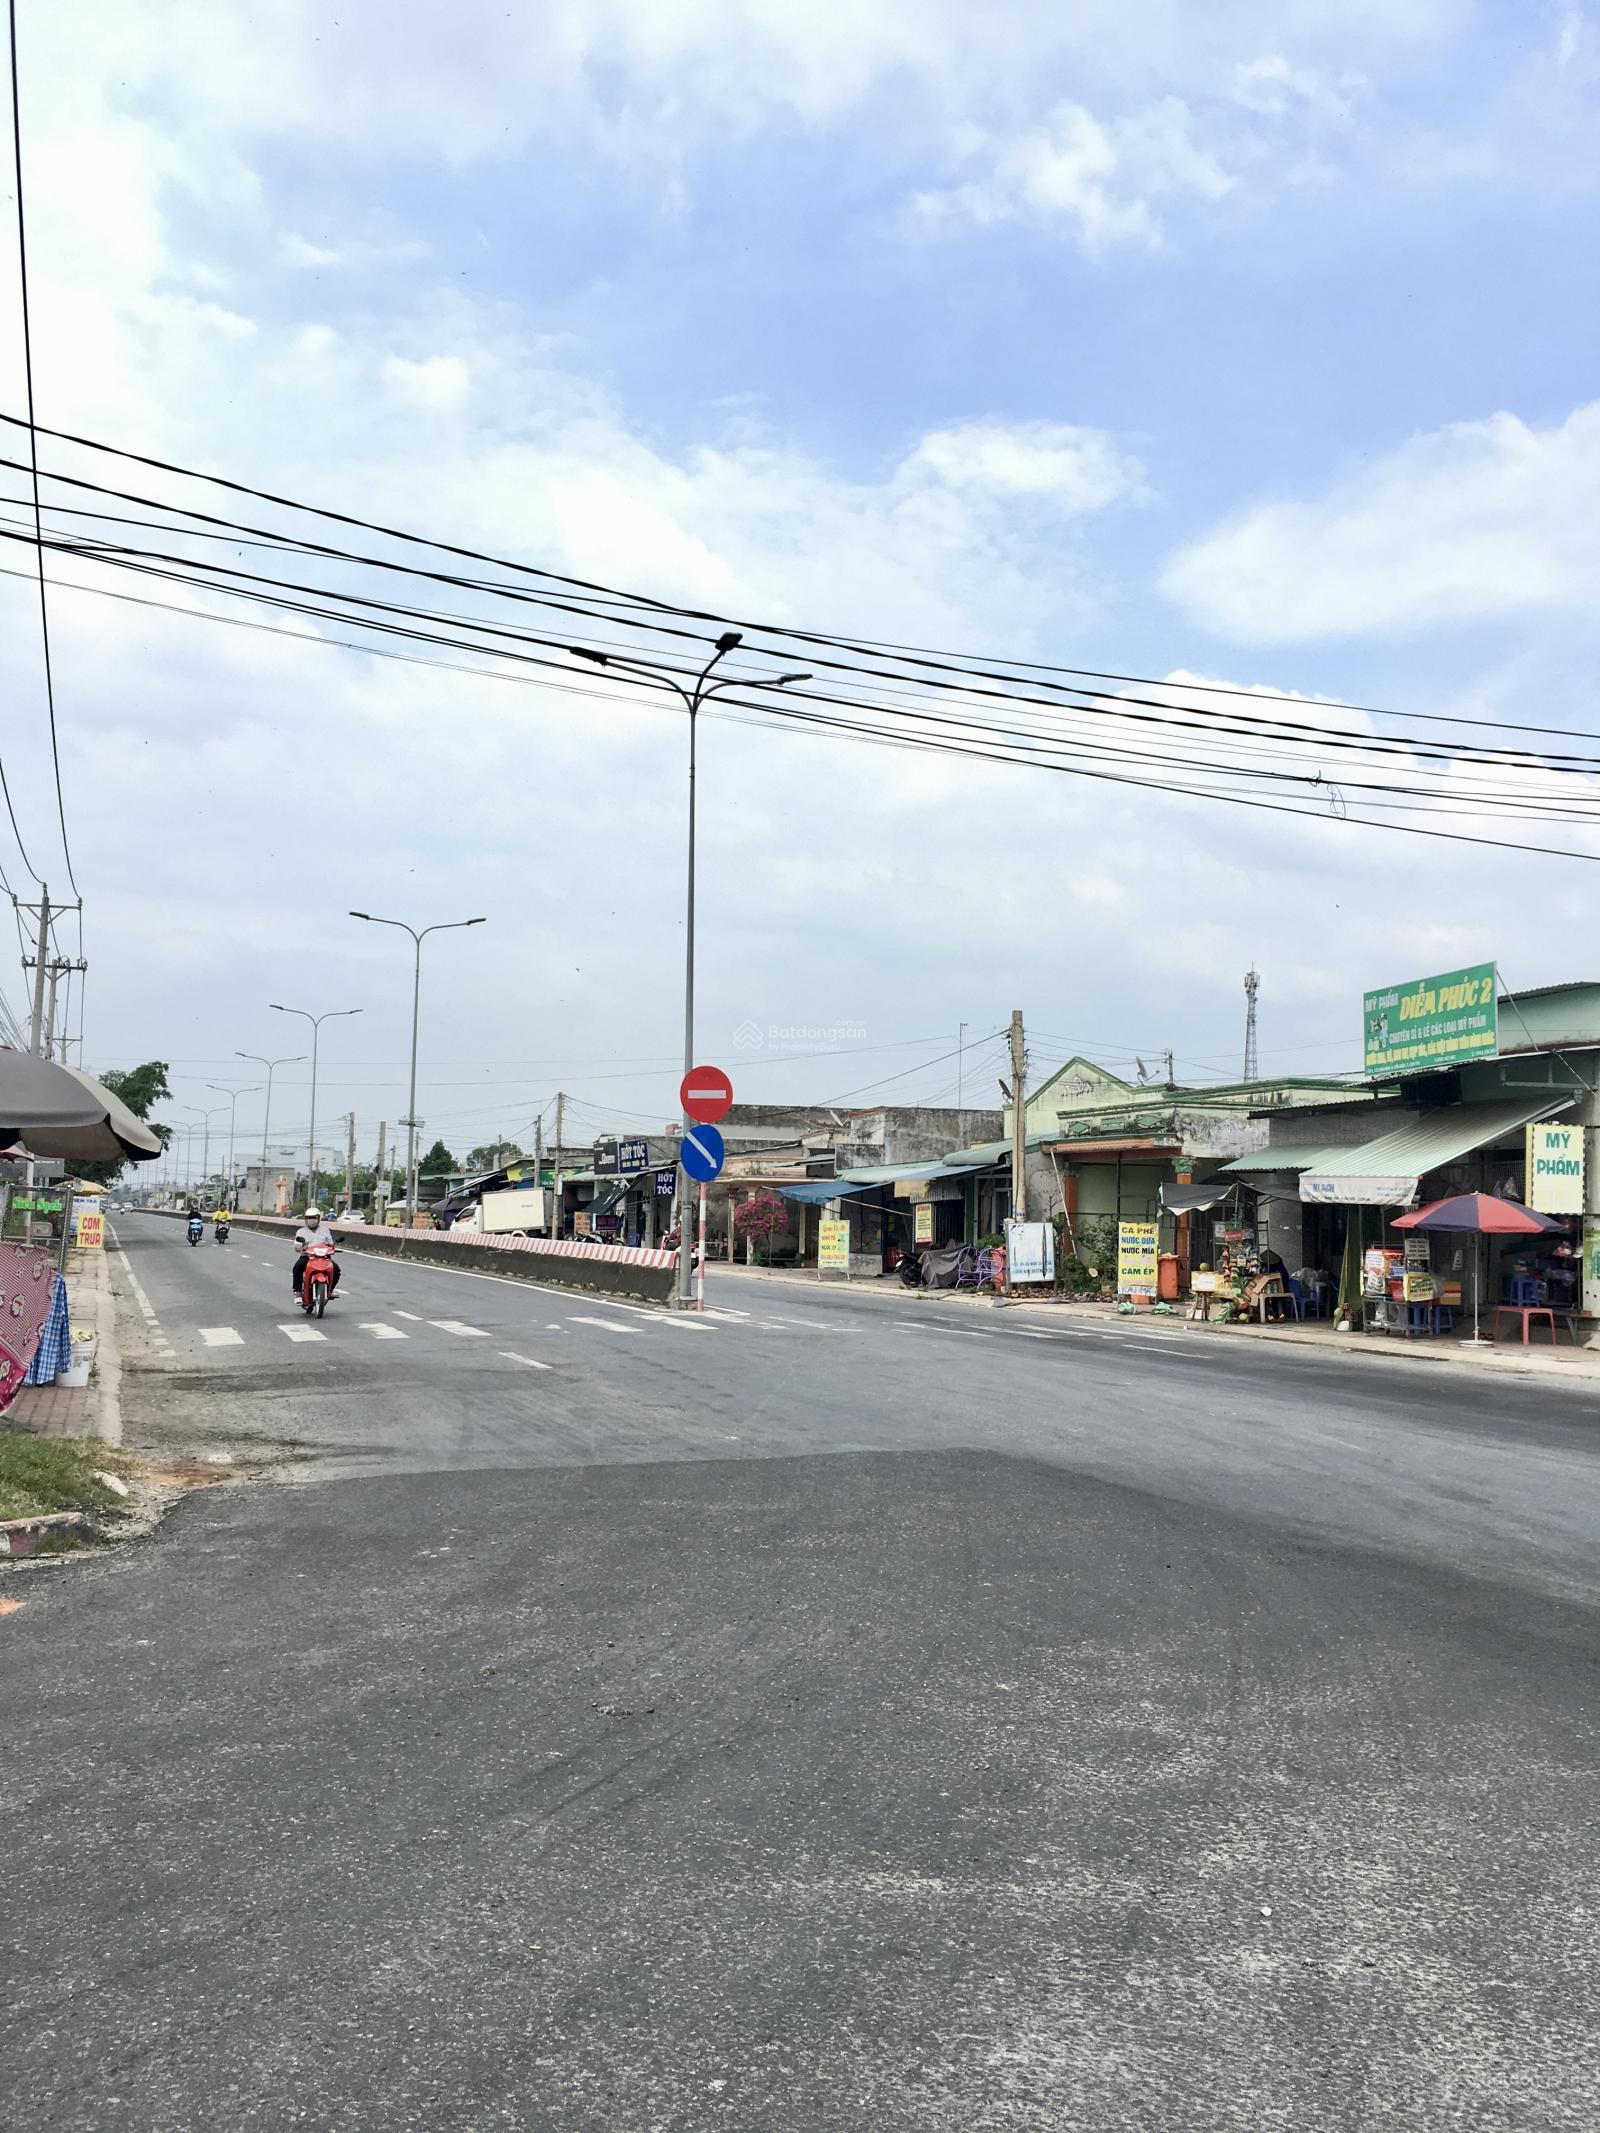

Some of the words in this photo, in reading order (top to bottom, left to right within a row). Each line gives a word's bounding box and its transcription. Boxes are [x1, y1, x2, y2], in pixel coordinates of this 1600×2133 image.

[1480, 977, 1493, 1005] 2
[1546, 1131, 1571, 1149] MỸ
[1537, 1154, 1580, 1176] PHẨM
[657, 1183, 673, 1195] TÓC
